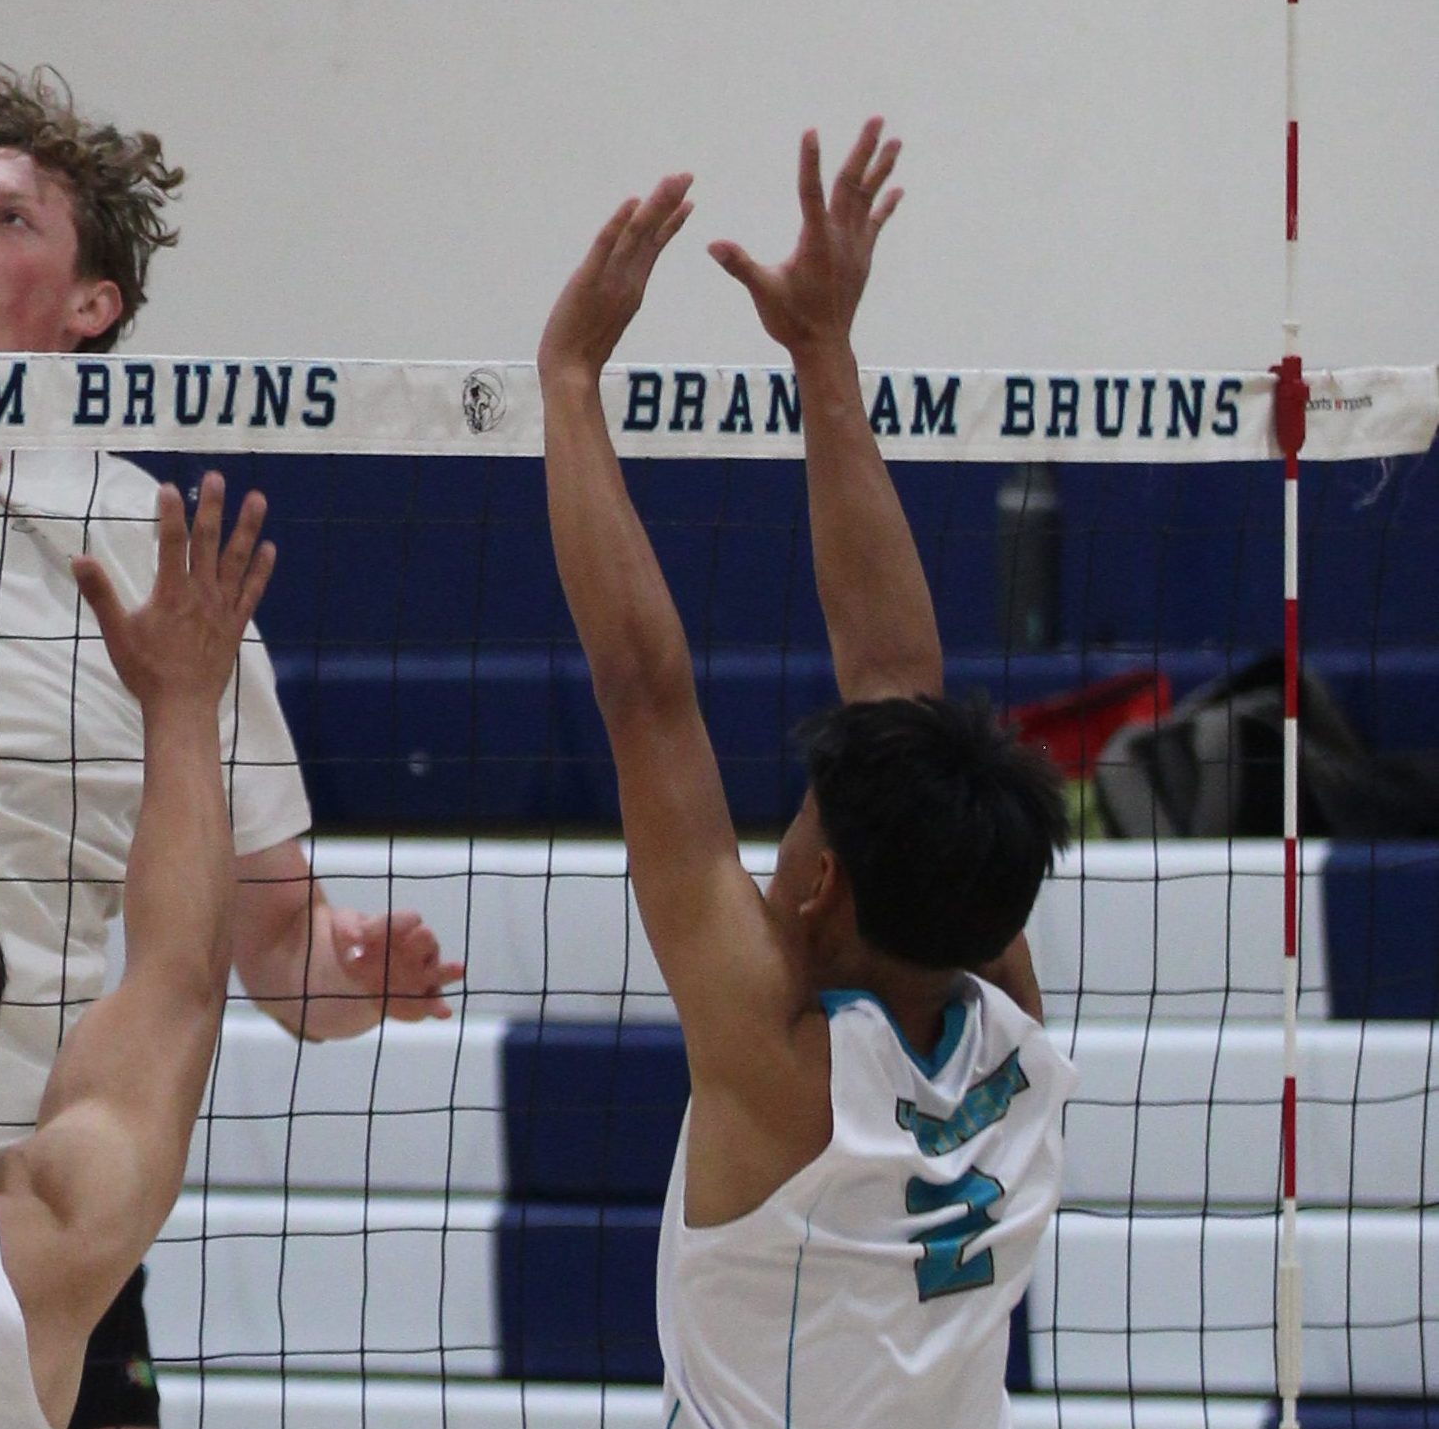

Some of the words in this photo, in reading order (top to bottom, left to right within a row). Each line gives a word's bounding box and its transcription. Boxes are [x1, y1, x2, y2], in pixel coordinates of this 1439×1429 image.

[73, 362, 337, 427] BRUINS
[621, 370, 961, 436] BRANAM
[1000, 376, 1243, 438] BRUINS
[905, 1164, 1005, 1303] 2
